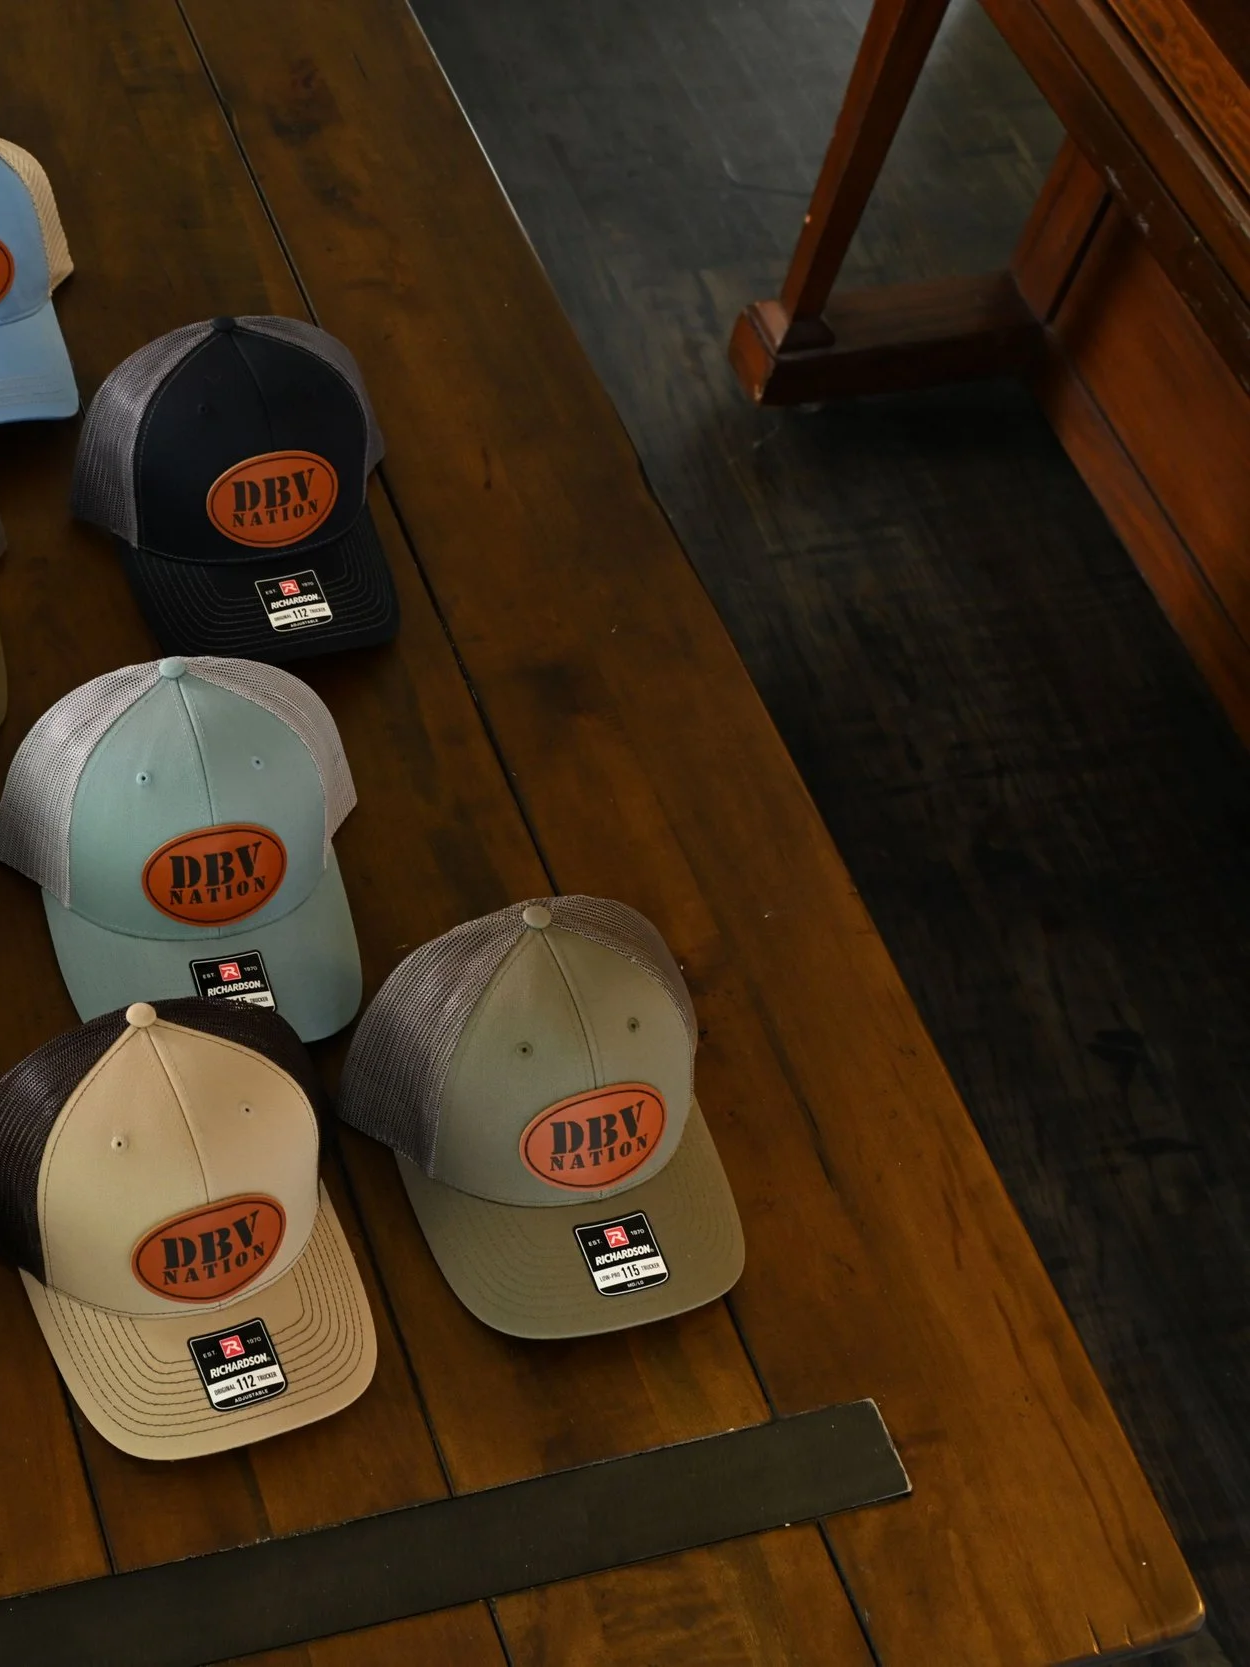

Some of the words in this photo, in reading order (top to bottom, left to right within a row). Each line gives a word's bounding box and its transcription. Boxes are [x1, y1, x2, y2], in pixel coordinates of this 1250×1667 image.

[232, 467, 316, 512] DBV
[232, 499, 318, 528] NATION
[270, 593, 319, 610] RICHARDSON
[292, 607, 309, 619] 112
[168, 840, 263, 889] DBV
[169, 875, 266, 906] NATION
[207, 980, 261, 997] RICHARDSON
[550, 1099, 646, 1155] DBV
[549, 1132, 649, 1172] NATION
[160, 1208, 260, 1270] DBV
[162, 1241, 265, 1286] NATION
[595, 1244, 651, 1266] RICHARDSON
[621, 1263, 640, 1279] 115
[246, 1336, 262, 1345] 1970
[209, 1353, 268, 1379] RICHARDSON
[214, 1384, 237, 1396] ORIGINAL
[236, 1374, 257, 1391] 112
[256, 1371, 278, 1382] TRUCKER
[234, 1388, 269, 1404] ADJUSTABLE
